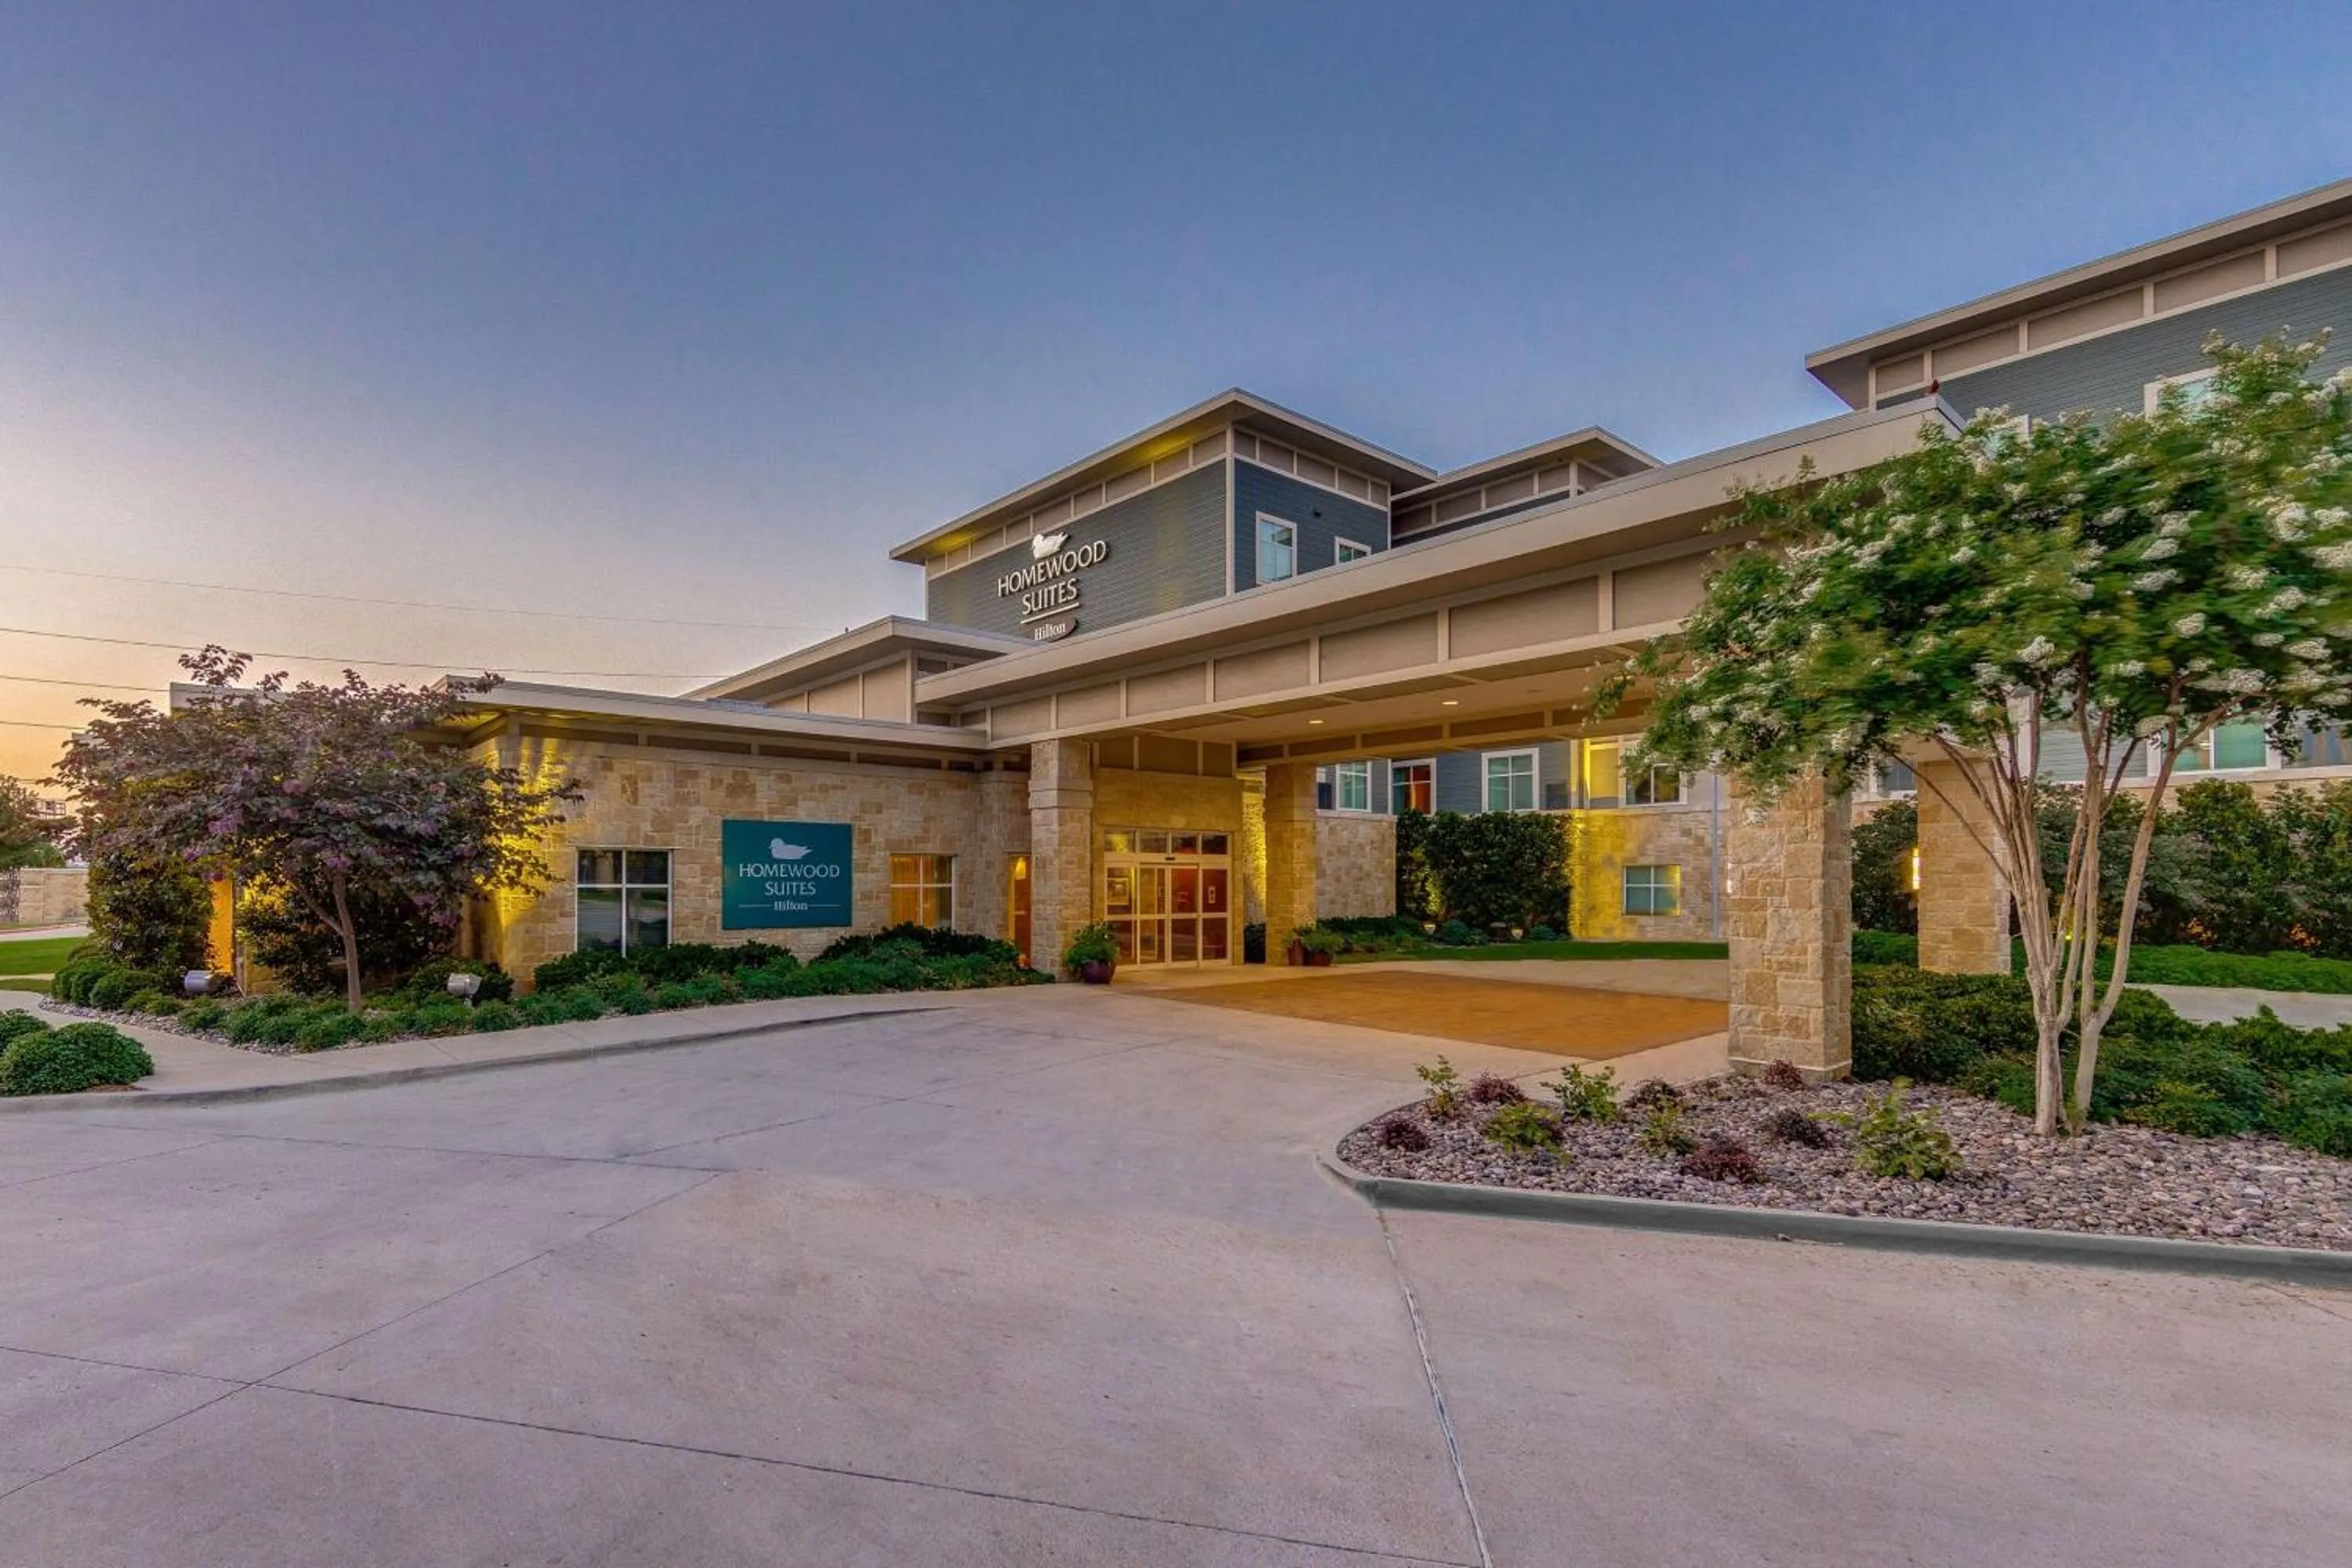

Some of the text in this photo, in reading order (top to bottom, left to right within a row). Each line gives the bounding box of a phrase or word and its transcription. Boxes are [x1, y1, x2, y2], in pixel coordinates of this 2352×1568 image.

[998, 540, 1107, 597] HOMEWOOD
[1022, 578, 1078, 615] SUITES
[1034, 623, 1066, 641] Hilton
[739, 863, 840, 879] HOMEWOOD
[764, 881, 816, 896] SUITES
[774, 900, 808, 911] Hilton
